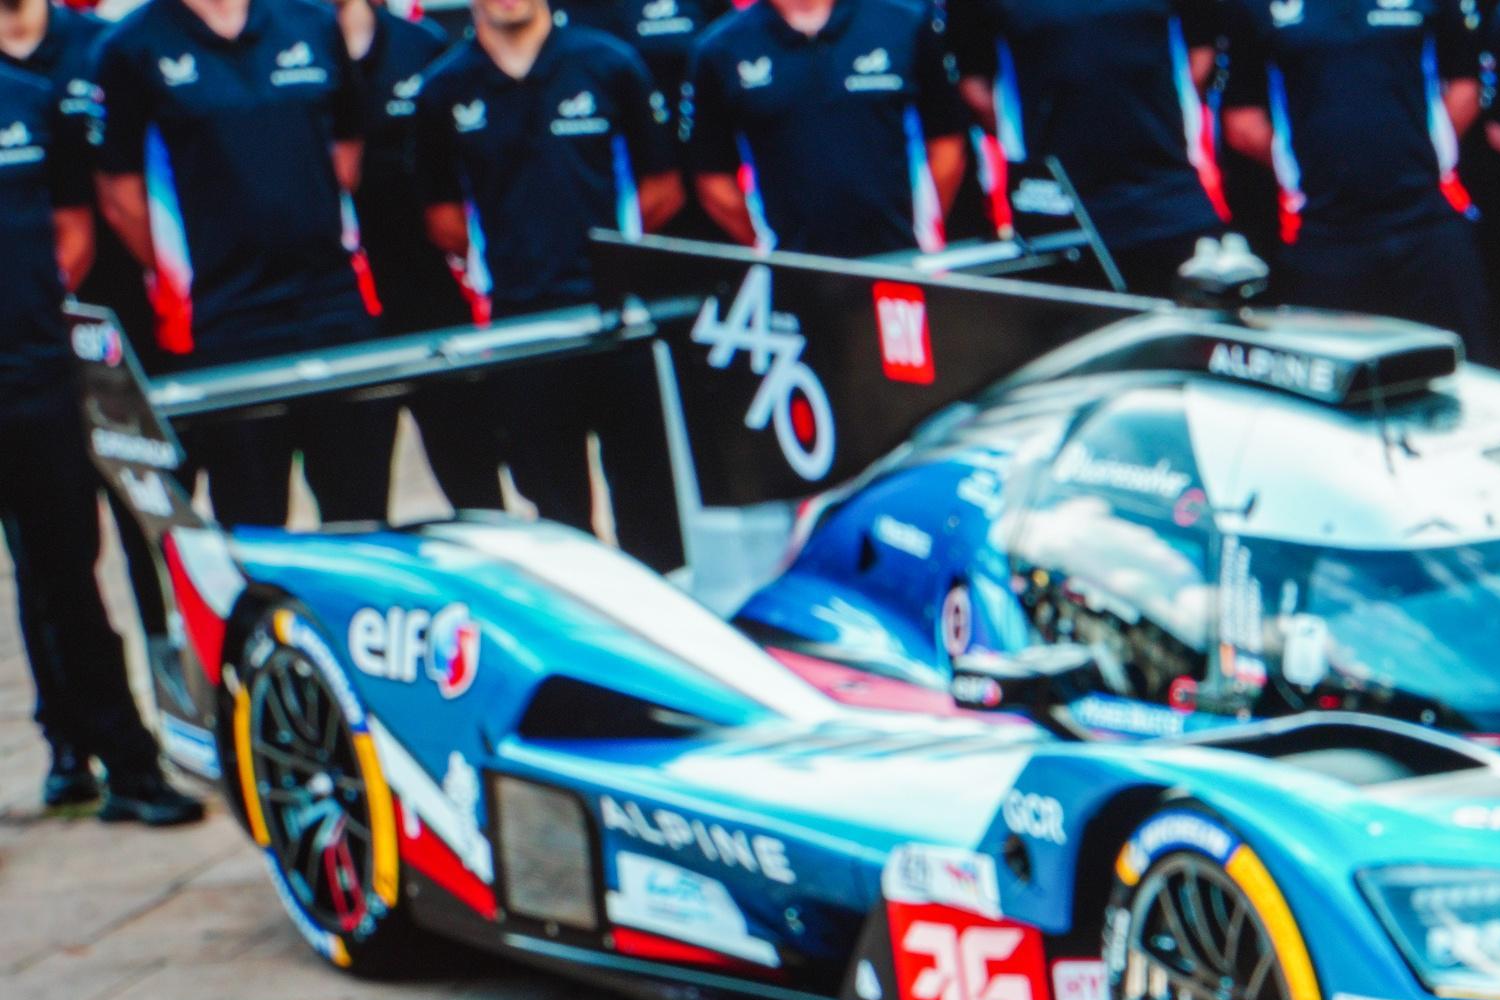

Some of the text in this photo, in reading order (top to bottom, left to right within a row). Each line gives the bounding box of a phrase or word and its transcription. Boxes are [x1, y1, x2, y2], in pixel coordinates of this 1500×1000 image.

[1207, 341, 1336, 393] ALPINE
[348, 603, 430, 683] elf
[598, 793, 799, 885] ALPINE
[1002, 787, 1068, 846] GCR
